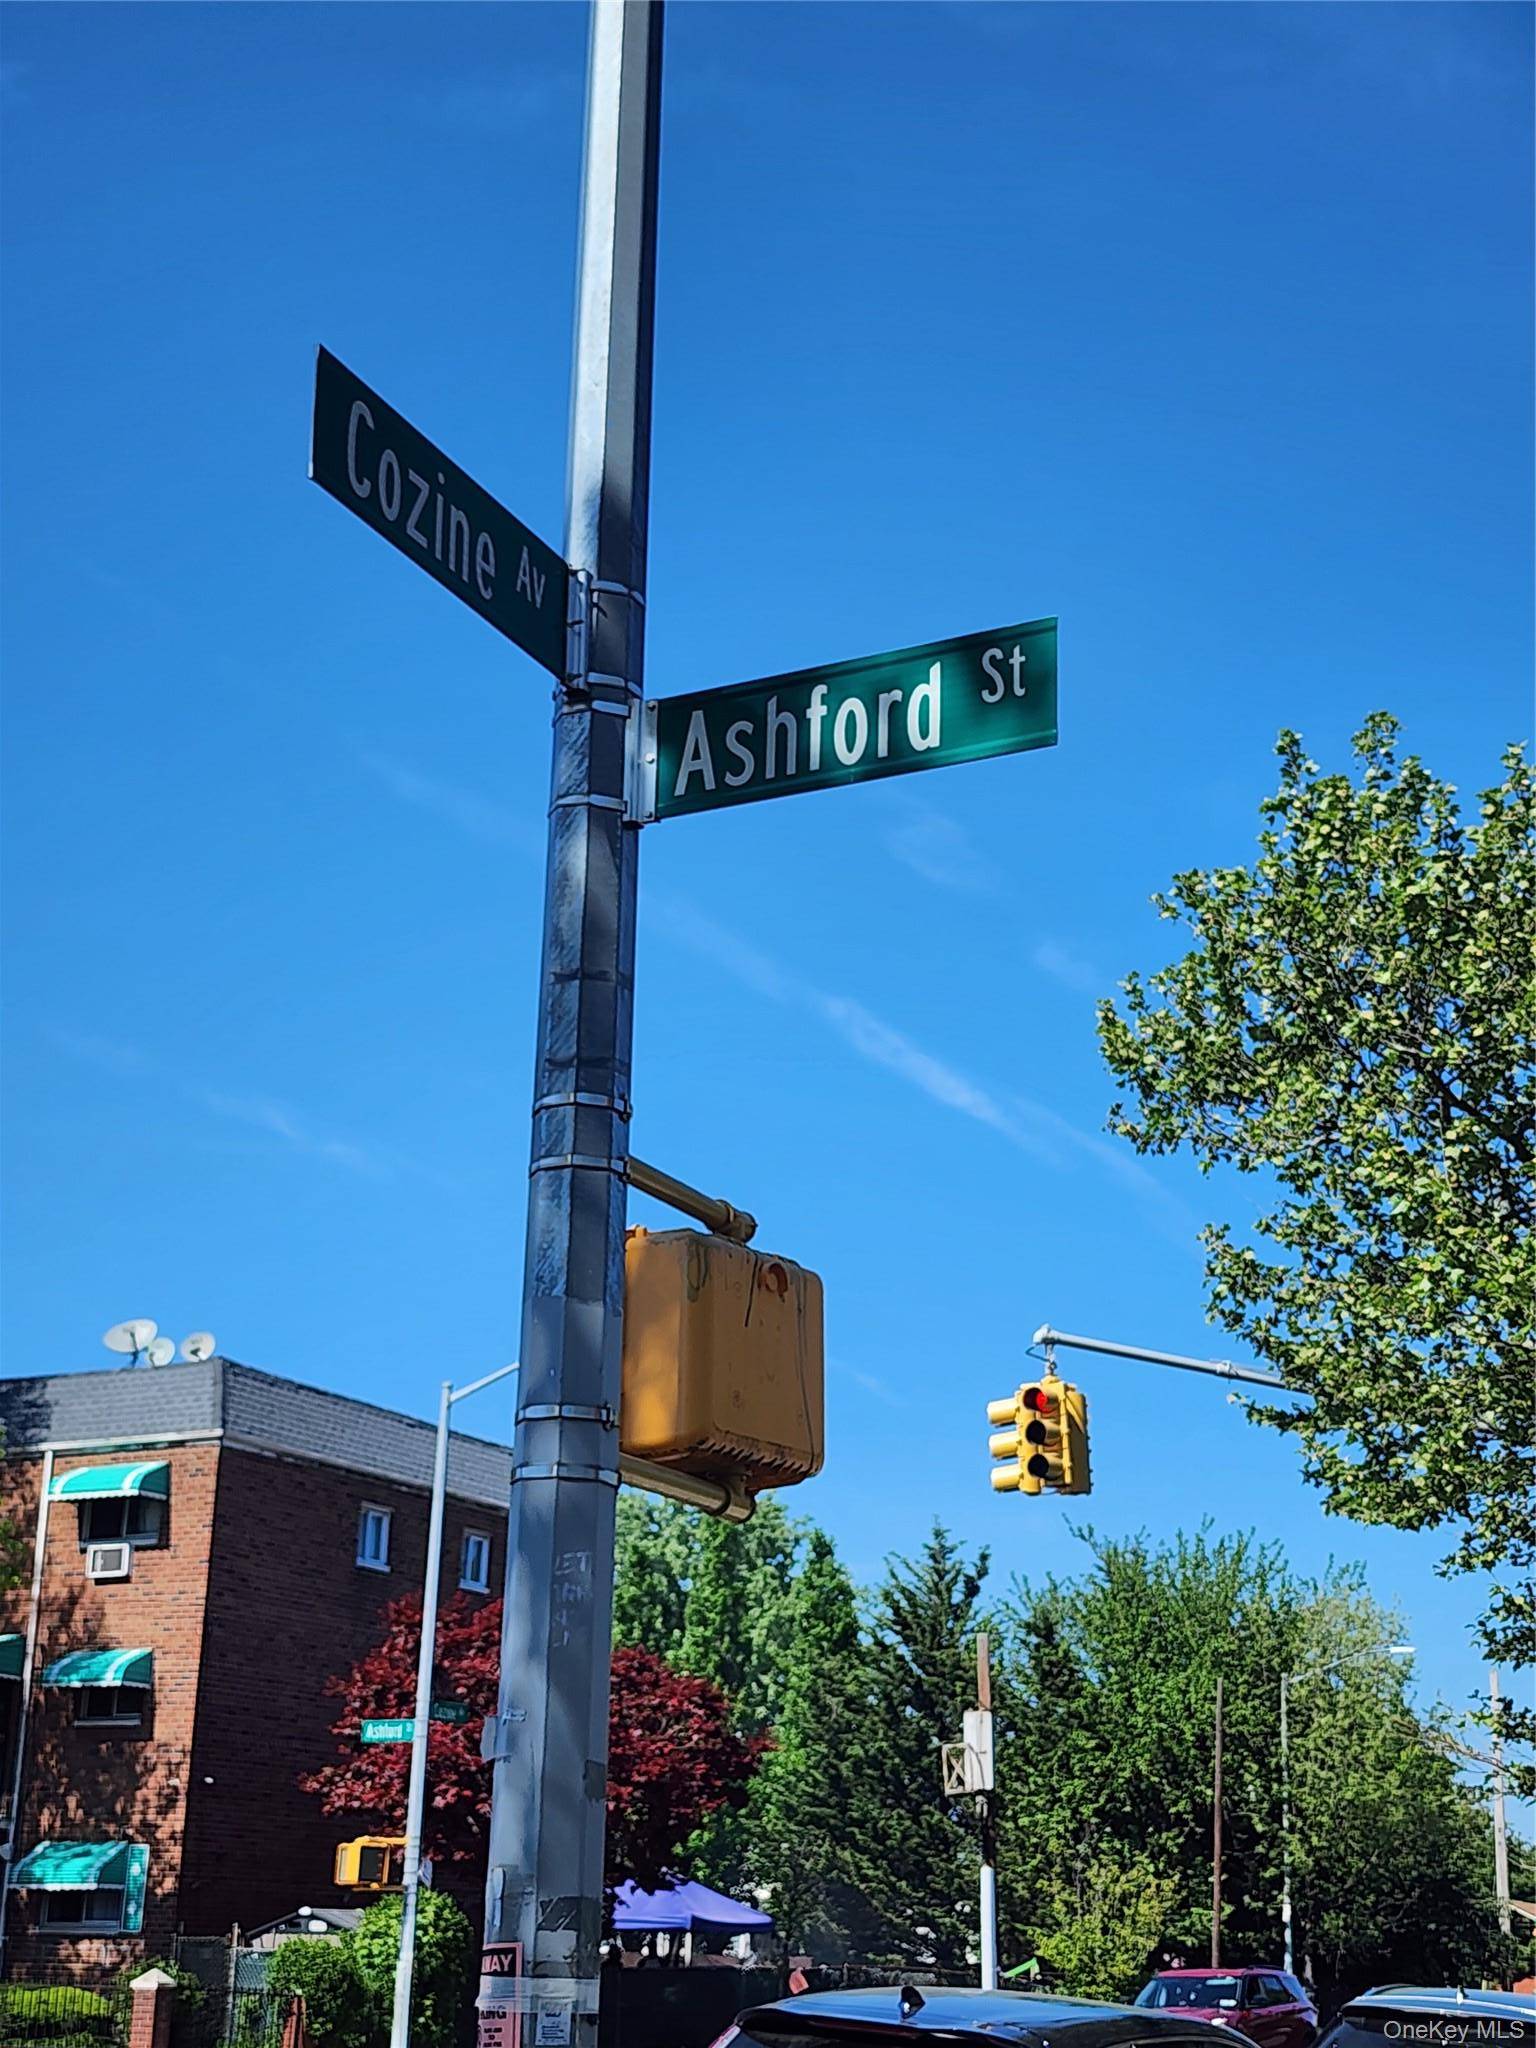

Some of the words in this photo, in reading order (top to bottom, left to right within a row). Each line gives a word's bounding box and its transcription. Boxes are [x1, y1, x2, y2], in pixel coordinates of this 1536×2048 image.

[347, 399, 497, 601] Cozine
[515, 544, 546, 609] Av
[674, 660, 942, 797] Ashford
[980, 643, 1027, 704] St
